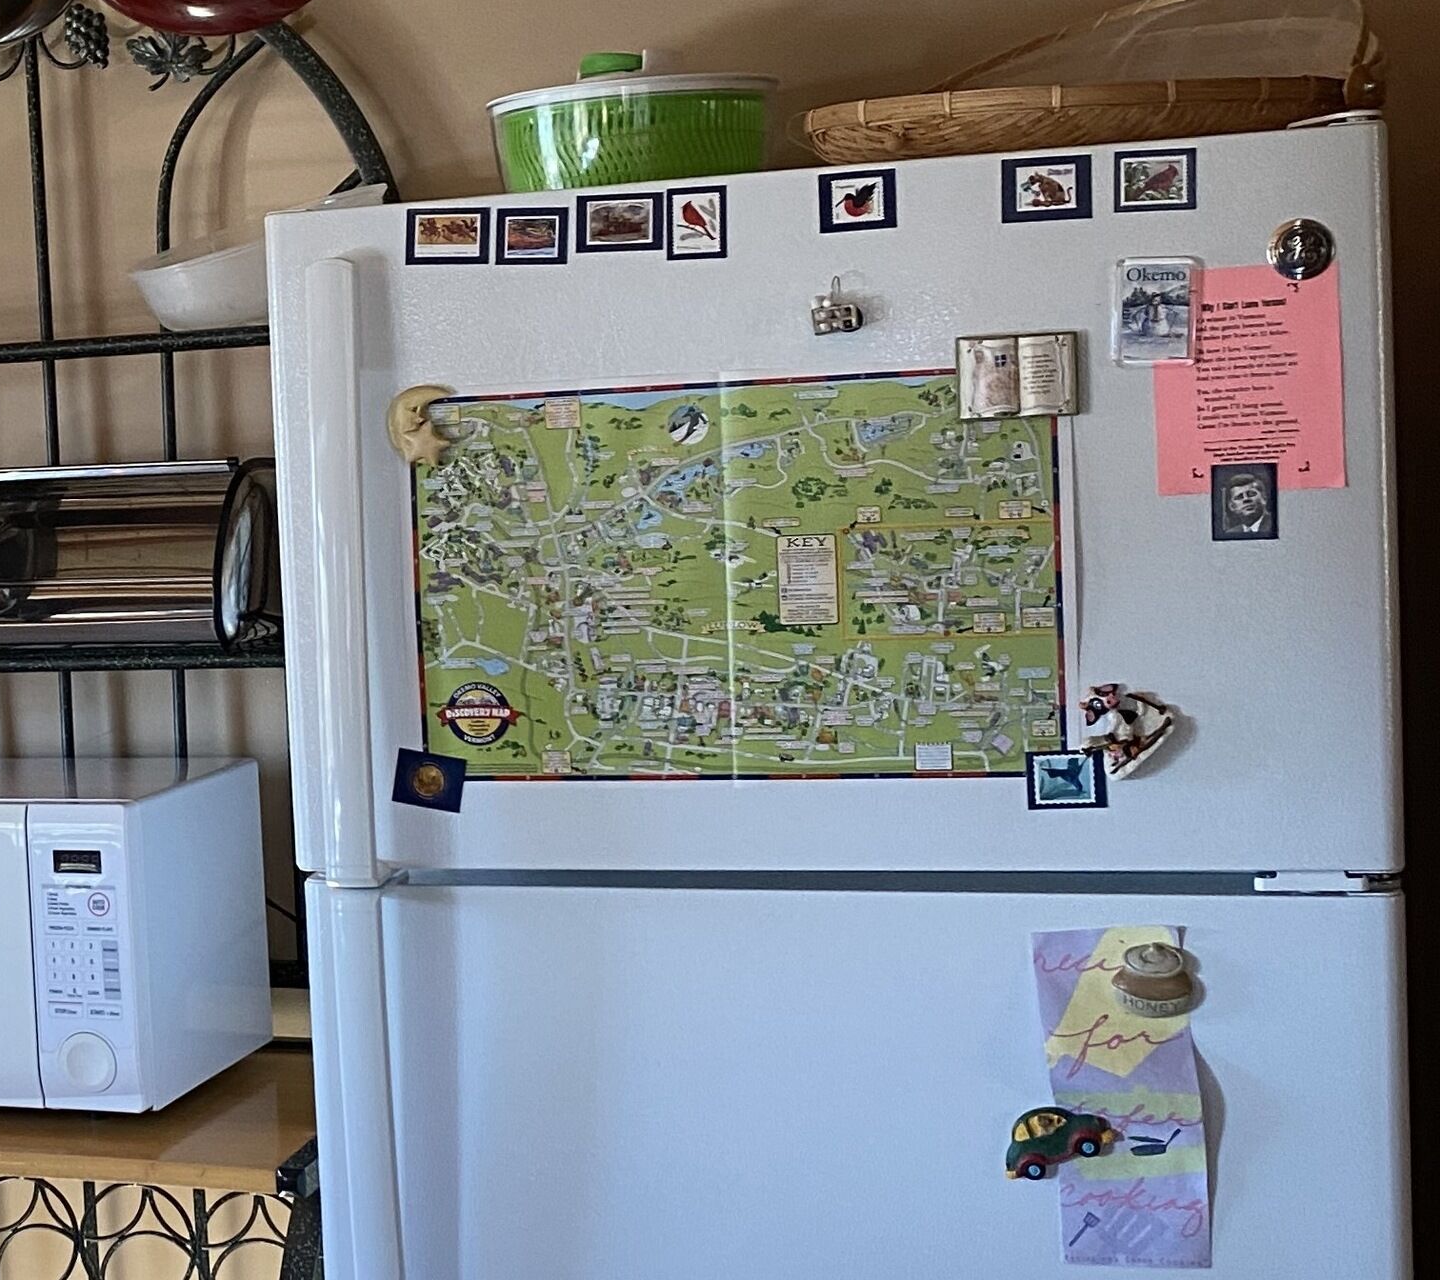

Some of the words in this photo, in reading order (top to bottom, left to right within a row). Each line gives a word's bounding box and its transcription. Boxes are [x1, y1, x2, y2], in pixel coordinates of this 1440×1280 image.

[1126, 267, 1187, 282] Okemo
[786, 536, 827, 548] KEY
[453, 683, 476, 699] OKEMO
[477, 683, 501, 698] VALLEY
[492, 707, 511, 718] MAP
[464, 734, 496, 744] VERMONT
[1123, 995, 1182, 1013] HONEY
[1049, 1014, 1185, 1080] for
